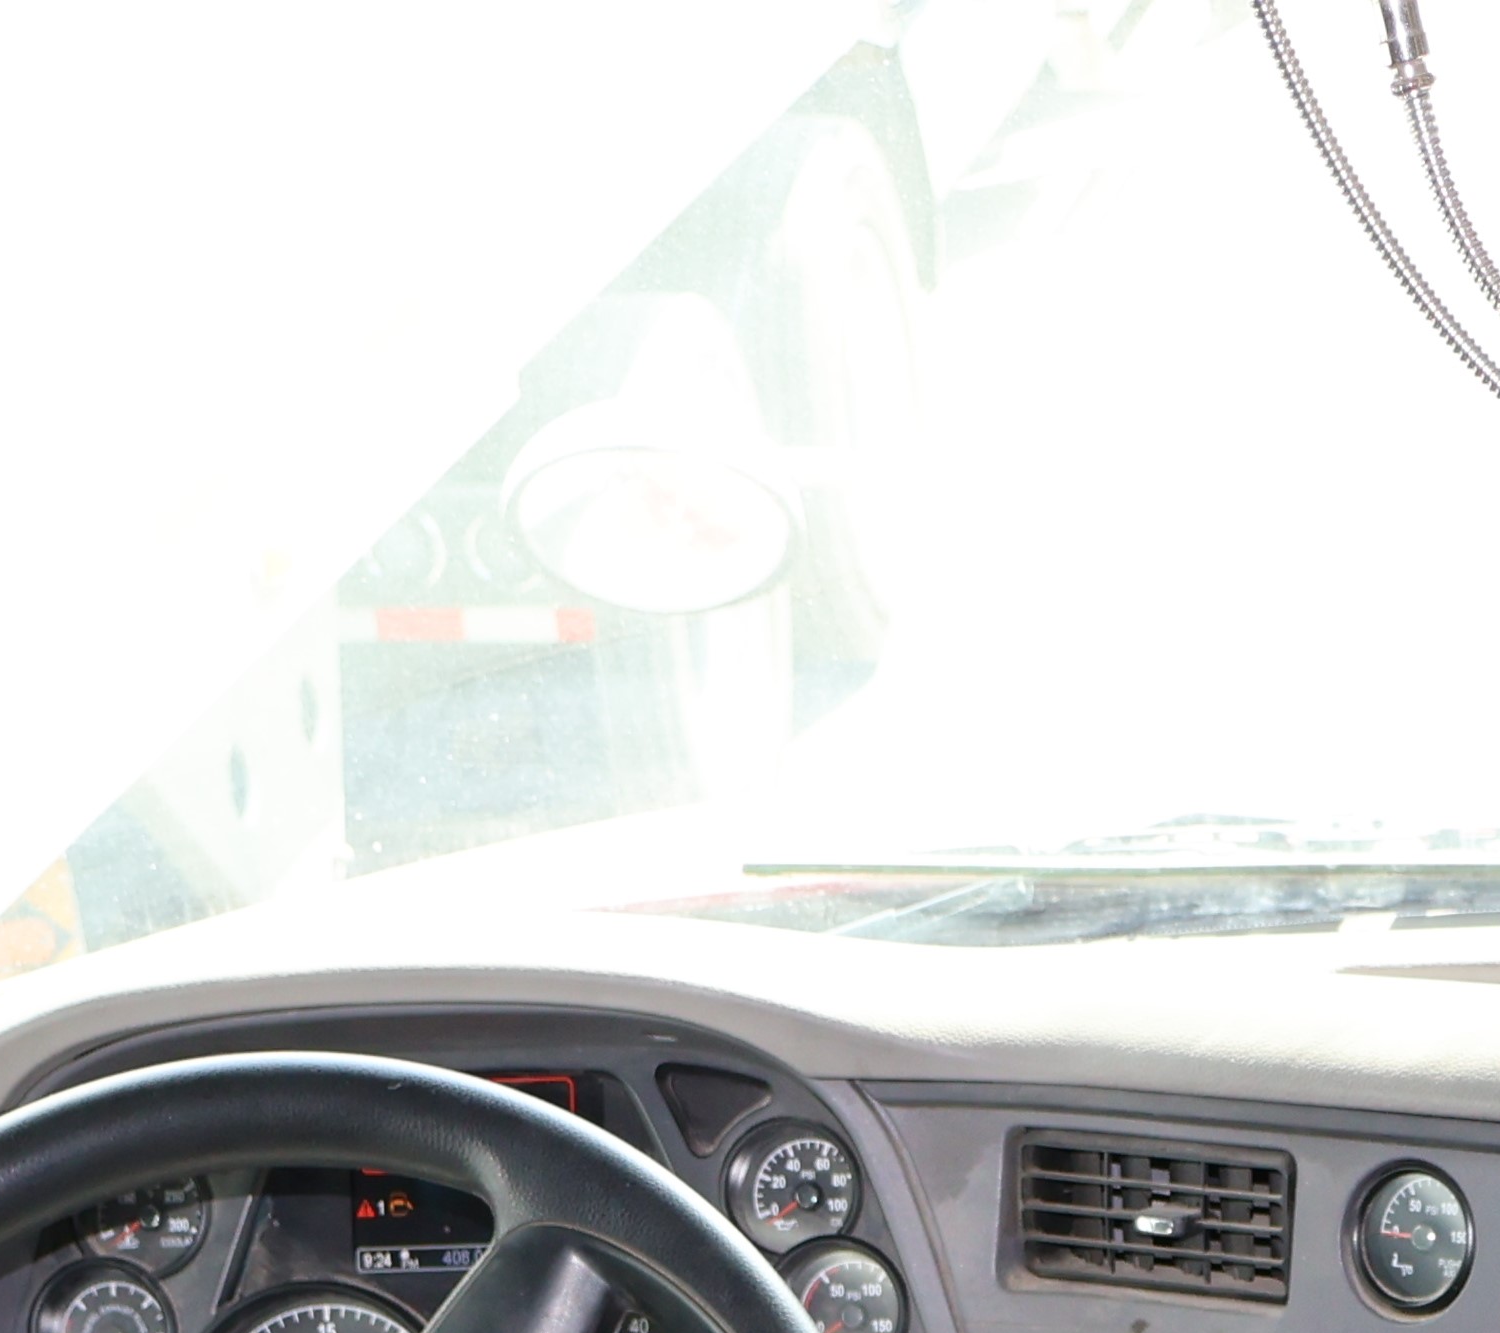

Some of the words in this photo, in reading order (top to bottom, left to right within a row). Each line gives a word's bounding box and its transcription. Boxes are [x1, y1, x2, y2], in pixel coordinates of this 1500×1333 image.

[786, 1158, 801, 1172] 40
[815, 1157, 830, 1171] 60
[771, 1175, 786, 1189] 20
[832, 1173, 847, 1187] 80
[771, 1201, 779, 1216] 0
[827, 1198, 848, 1212] 100
[1408, 1199, 1422, 1213] 50
[830, 1284, 845, 1298] 50
[861, 1284, 882, 1297] 100
[871, 1319, 893, 1333] 150
